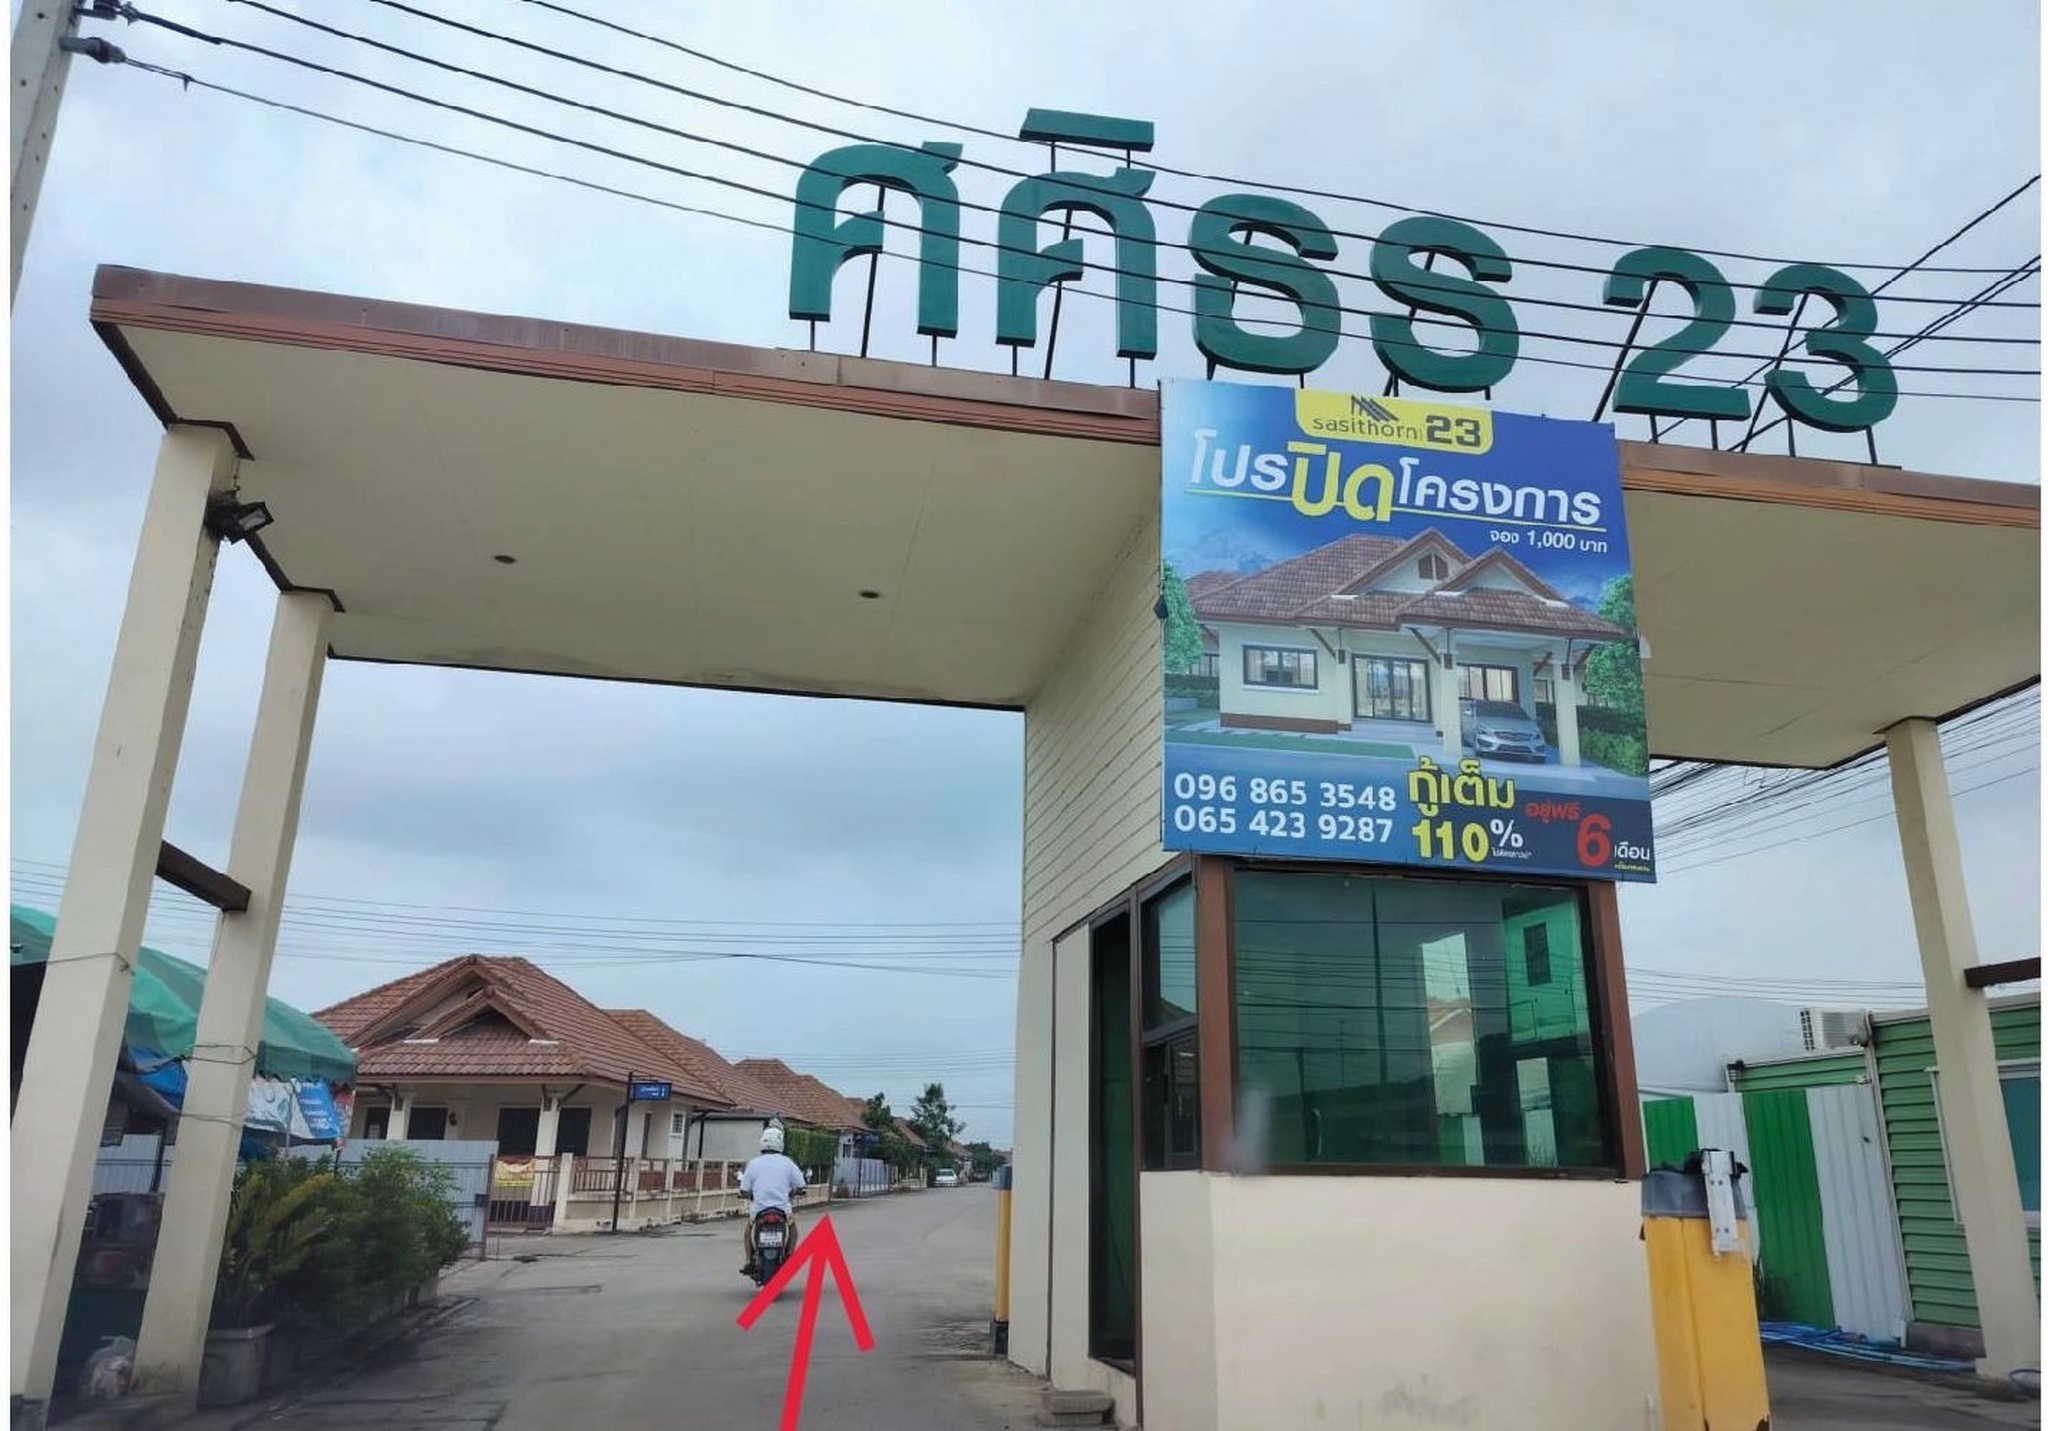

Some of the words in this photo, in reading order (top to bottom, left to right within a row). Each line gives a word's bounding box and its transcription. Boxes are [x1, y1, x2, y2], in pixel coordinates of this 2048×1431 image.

[789, 108, 1520, 394] ศศิธร
[1603, 243, 1899, 433] 23
[1312, 417, 1418, 441] sasithorn
[1425, 414, 1481, 448] 23
[1189, 429, 1602, 525] โปรปิดโครงการ
[1489, 529, 1520, 544] จอง
[1527, 529, 1576, 550] 1,000
[1580, 539, 1608, 553] บาท
[1173, 772, 1237, 802] 096
[1249, 777, 1307, 805] 865
[1319, 782, 1397, 811] 3548
[1408, 756, 1516, 817] กู้เต็ม
[1173, 804, 1237, 834] 065
[1249, 809, 1306, 838] 423
[1317, 813, 1394, 843] 9287
[1411, 818, 1524, 863] 110%
[1576, 813, 1612, 867] 6
[1614, 841, 1651, 861] เดือน
